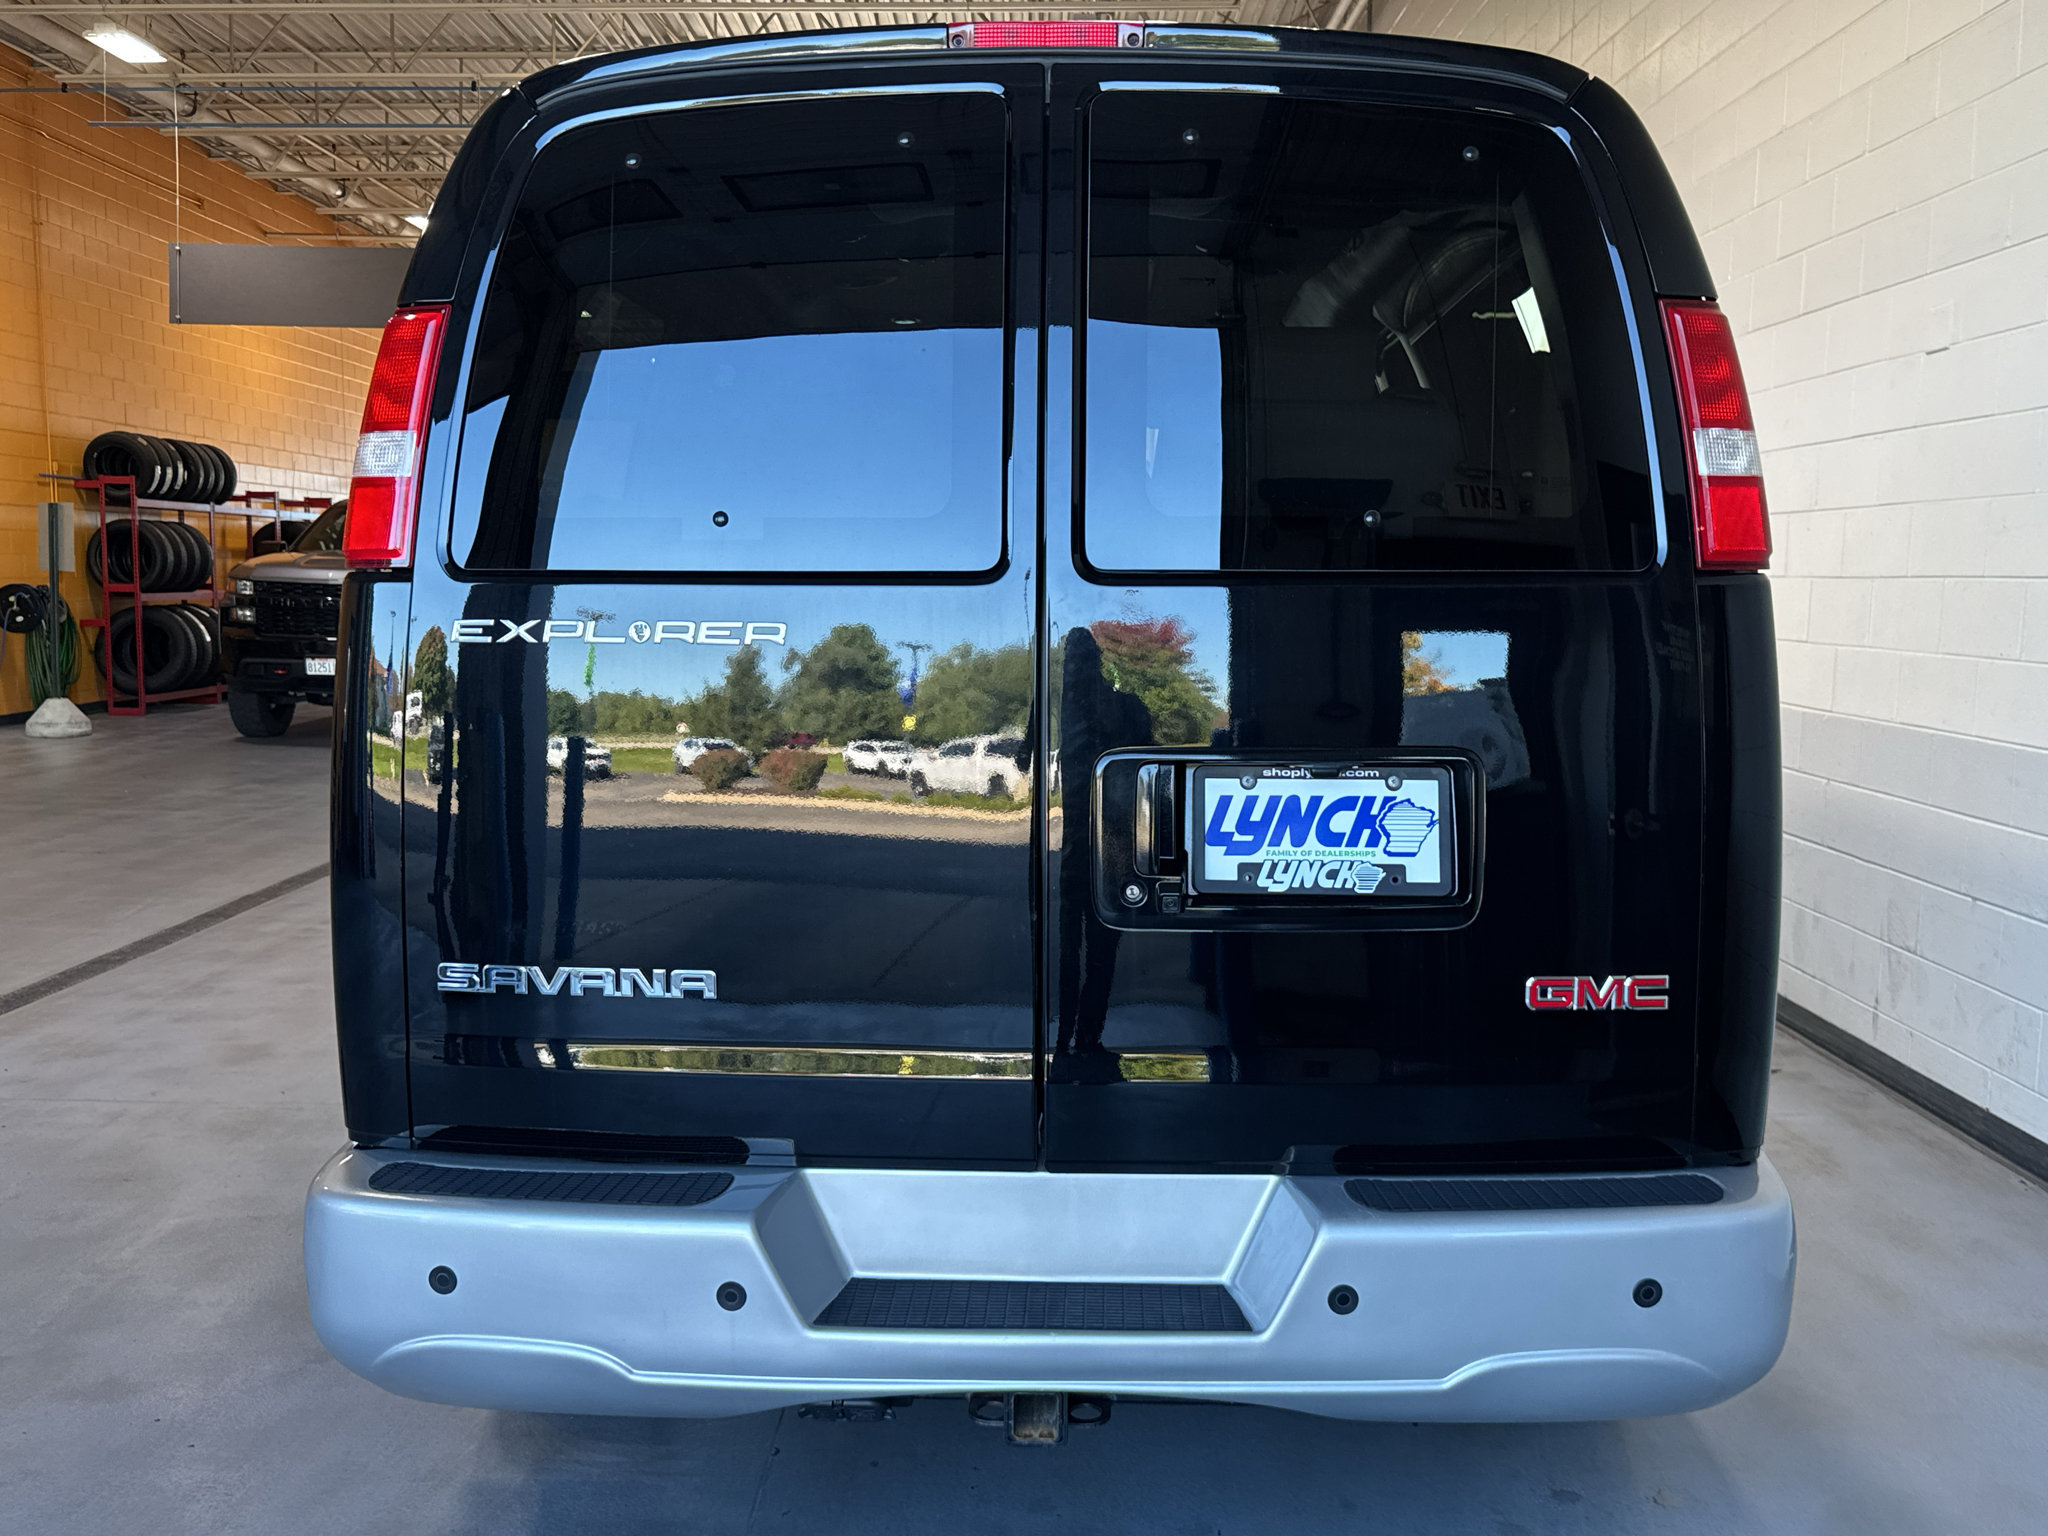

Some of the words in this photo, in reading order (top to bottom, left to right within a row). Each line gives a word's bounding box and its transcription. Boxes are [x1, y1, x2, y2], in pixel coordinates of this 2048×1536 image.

[450, 619, 787, 646] EXPLORER
[1262, 767, 1380, 779] shoply.com
[1205, 794, 1397, 856] LYNCH
[1265, 849, 1299, 857] FAMILY
[1301, 849, 1313, 857] OF
[1315, 849, 1377, 858] DEALERSHIPS
[1256, 859, 1362, 892] LYNCH
[437, 962, 718, 1000] SAVANA
[1525, 975, 1669, 1010] GMC
